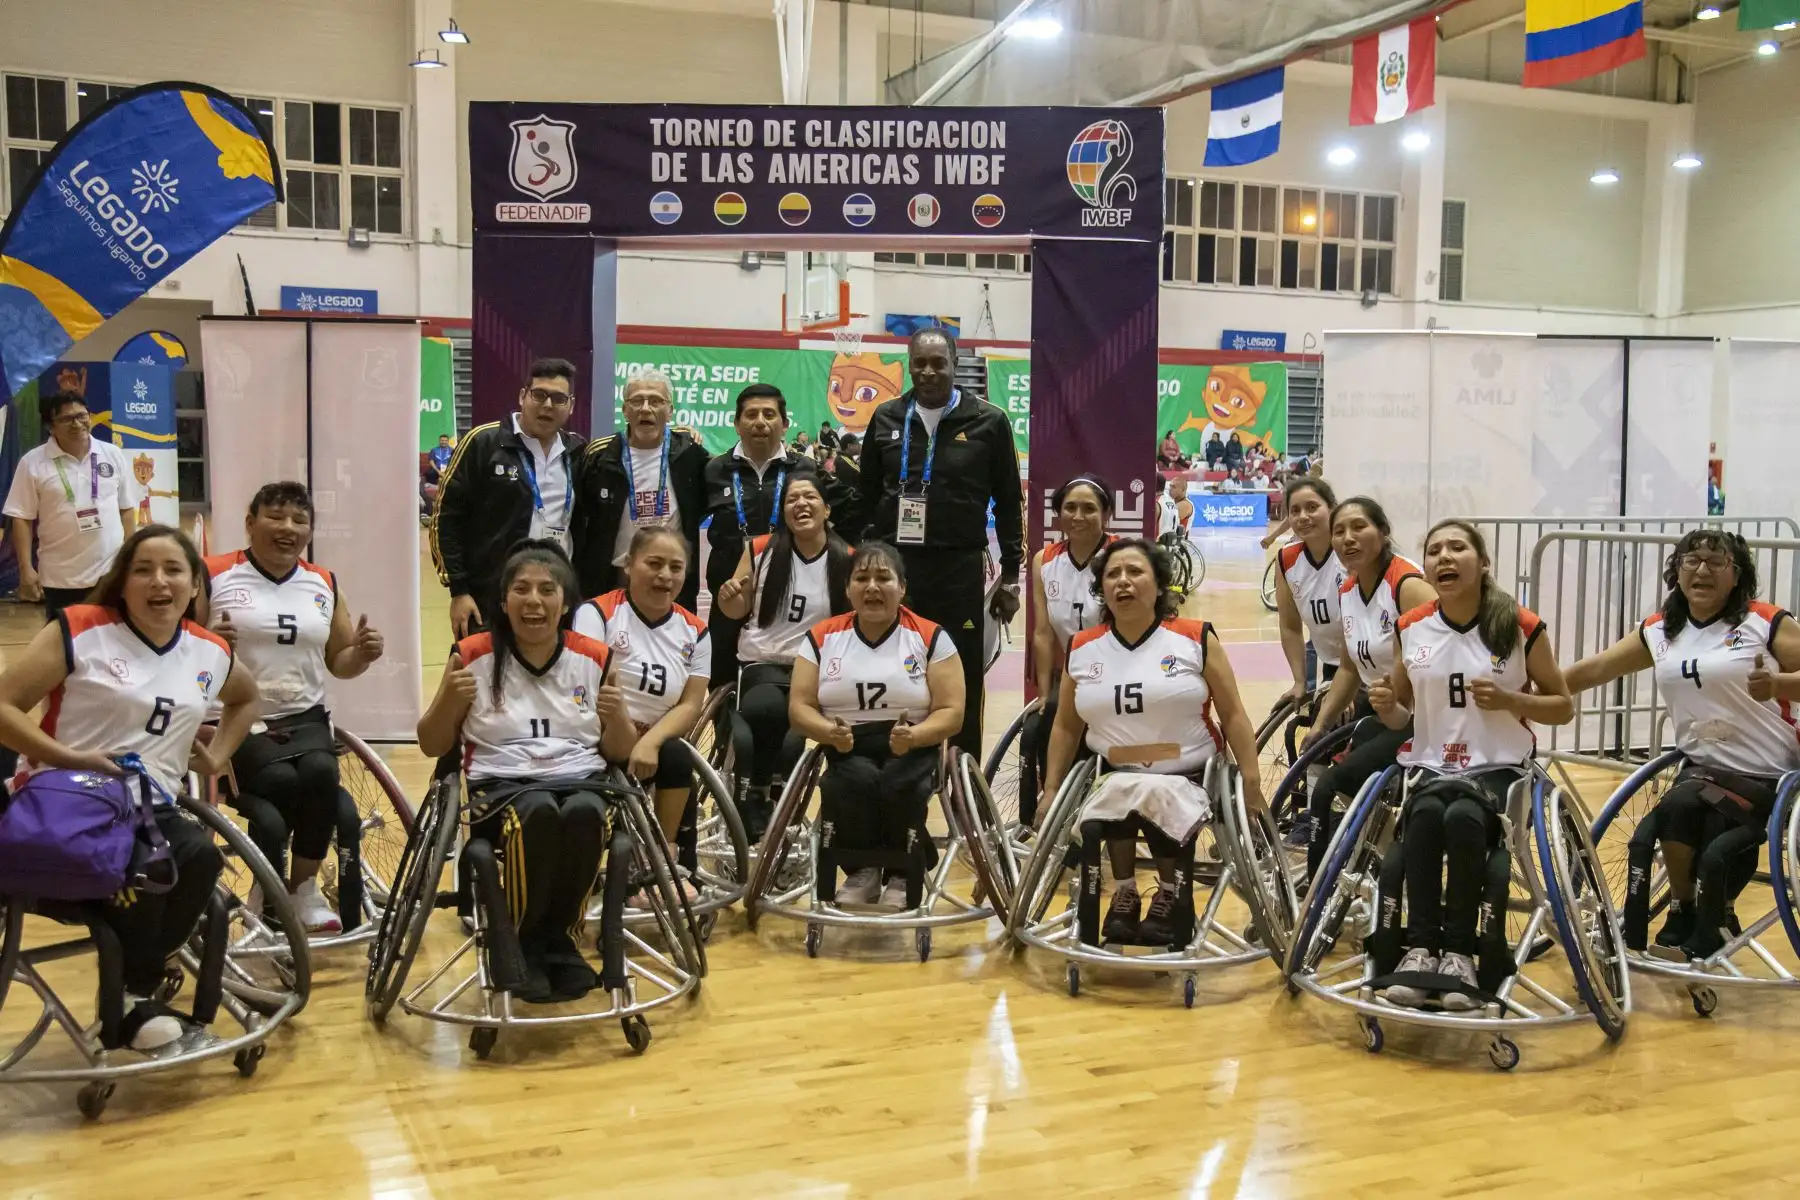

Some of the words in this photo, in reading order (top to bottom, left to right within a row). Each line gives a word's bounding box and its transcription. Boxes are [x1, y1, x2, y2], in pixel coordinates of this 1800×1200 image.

[650, 118, 754, 147] TORNEO
[763, 119, 797, 148] DE
[805, 119, 1006, 149] CLASIFICACION
[651, 152, 688, 183] DE
[701, 152, 755, 184] LAS
[767, 153, 920, 185] AMERICAS
[934, 154, 1006, 185] IWBF
[56, 178, 107, 238] Seguimos
[499, 204, 588, 221] FEDENADIF
[1081, 208, 1133, 227] IWBF
[658, 363, 707, 382] ESTA
[710, 366, 761, 384] SEDE
[702, 387, 729, 405] EN
[788, 594, 807, 623] 9
[1073, 602, 1084, 630] 7
[1310, 599, 1331, 625] 10
[277, 613, 298, 645] 5
[1357, 640, 1377, 669] 14
[638, 661, 667, 697] 13
[1681, 658, 1703, 689] 4
[855, 682, 888, 710] 12
[1114, 682, 1144, 716] 15
[1449, 672, 1467, 708] 8
[145, 696, 176, 736] 6
[529, 718, 550, 738] 11
